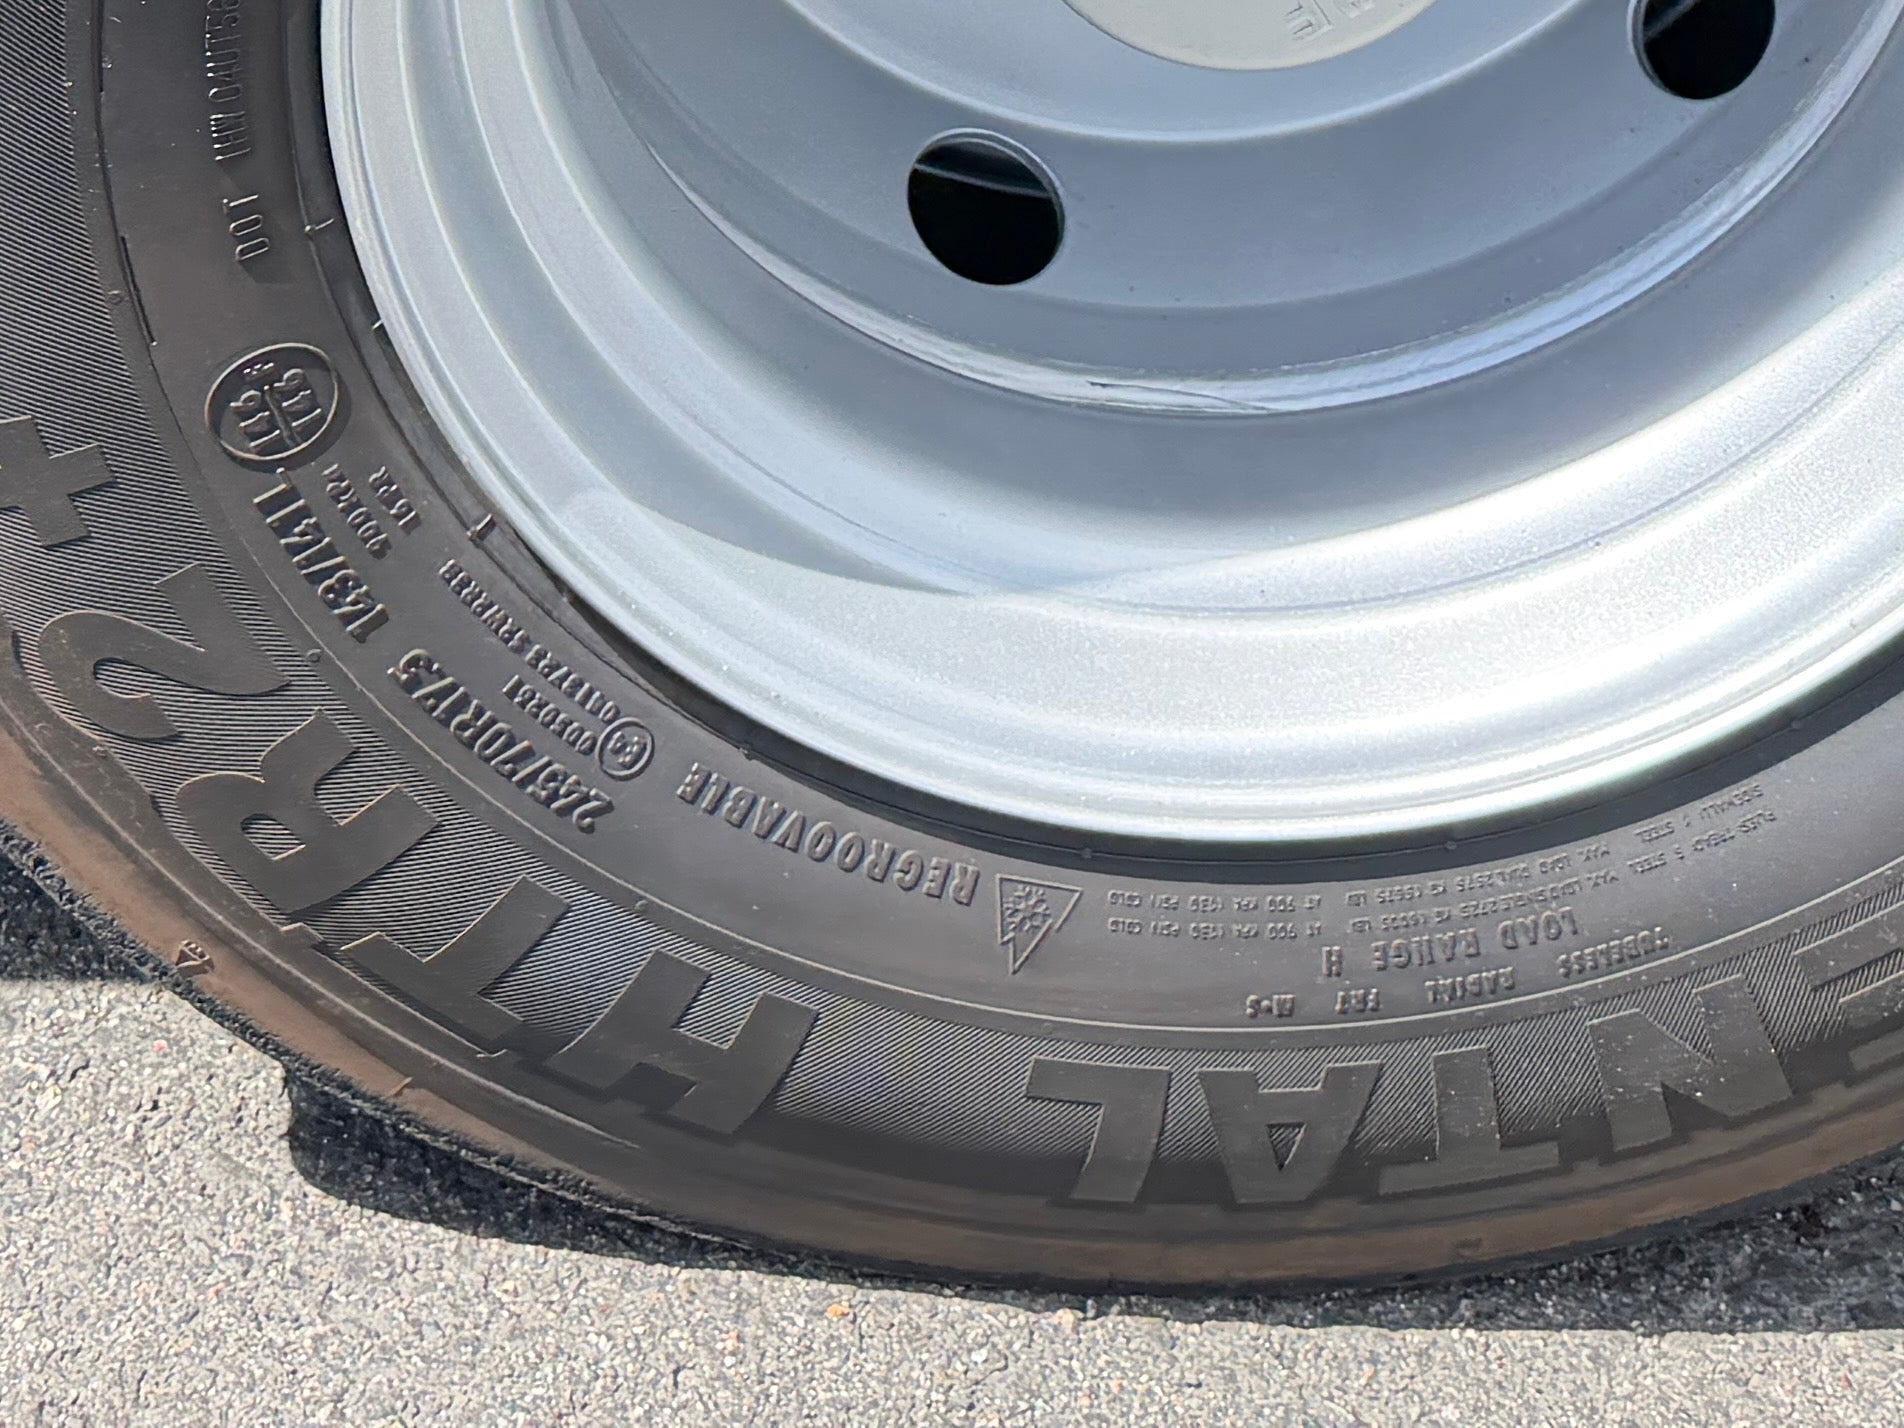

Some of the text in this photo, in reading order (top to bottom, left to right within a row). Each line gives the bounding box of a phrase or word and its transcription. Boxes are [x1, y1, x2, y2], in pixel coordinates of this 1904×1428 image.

[220, 192, 274, 265] DOT
[227, 389, 288, 460] 146
[267, 365, 329, 440] 146
[242, 470, 619, 839] 245/70R17.5 143/141L
[669, 754, 985, 912] REGROOVABLE
[1319, 903, 1581, 978] LOAD RANGE H
[1554, 922, 1671, 980] TUBELESS
[1426, 964, 1518, 1006] RADIAL
